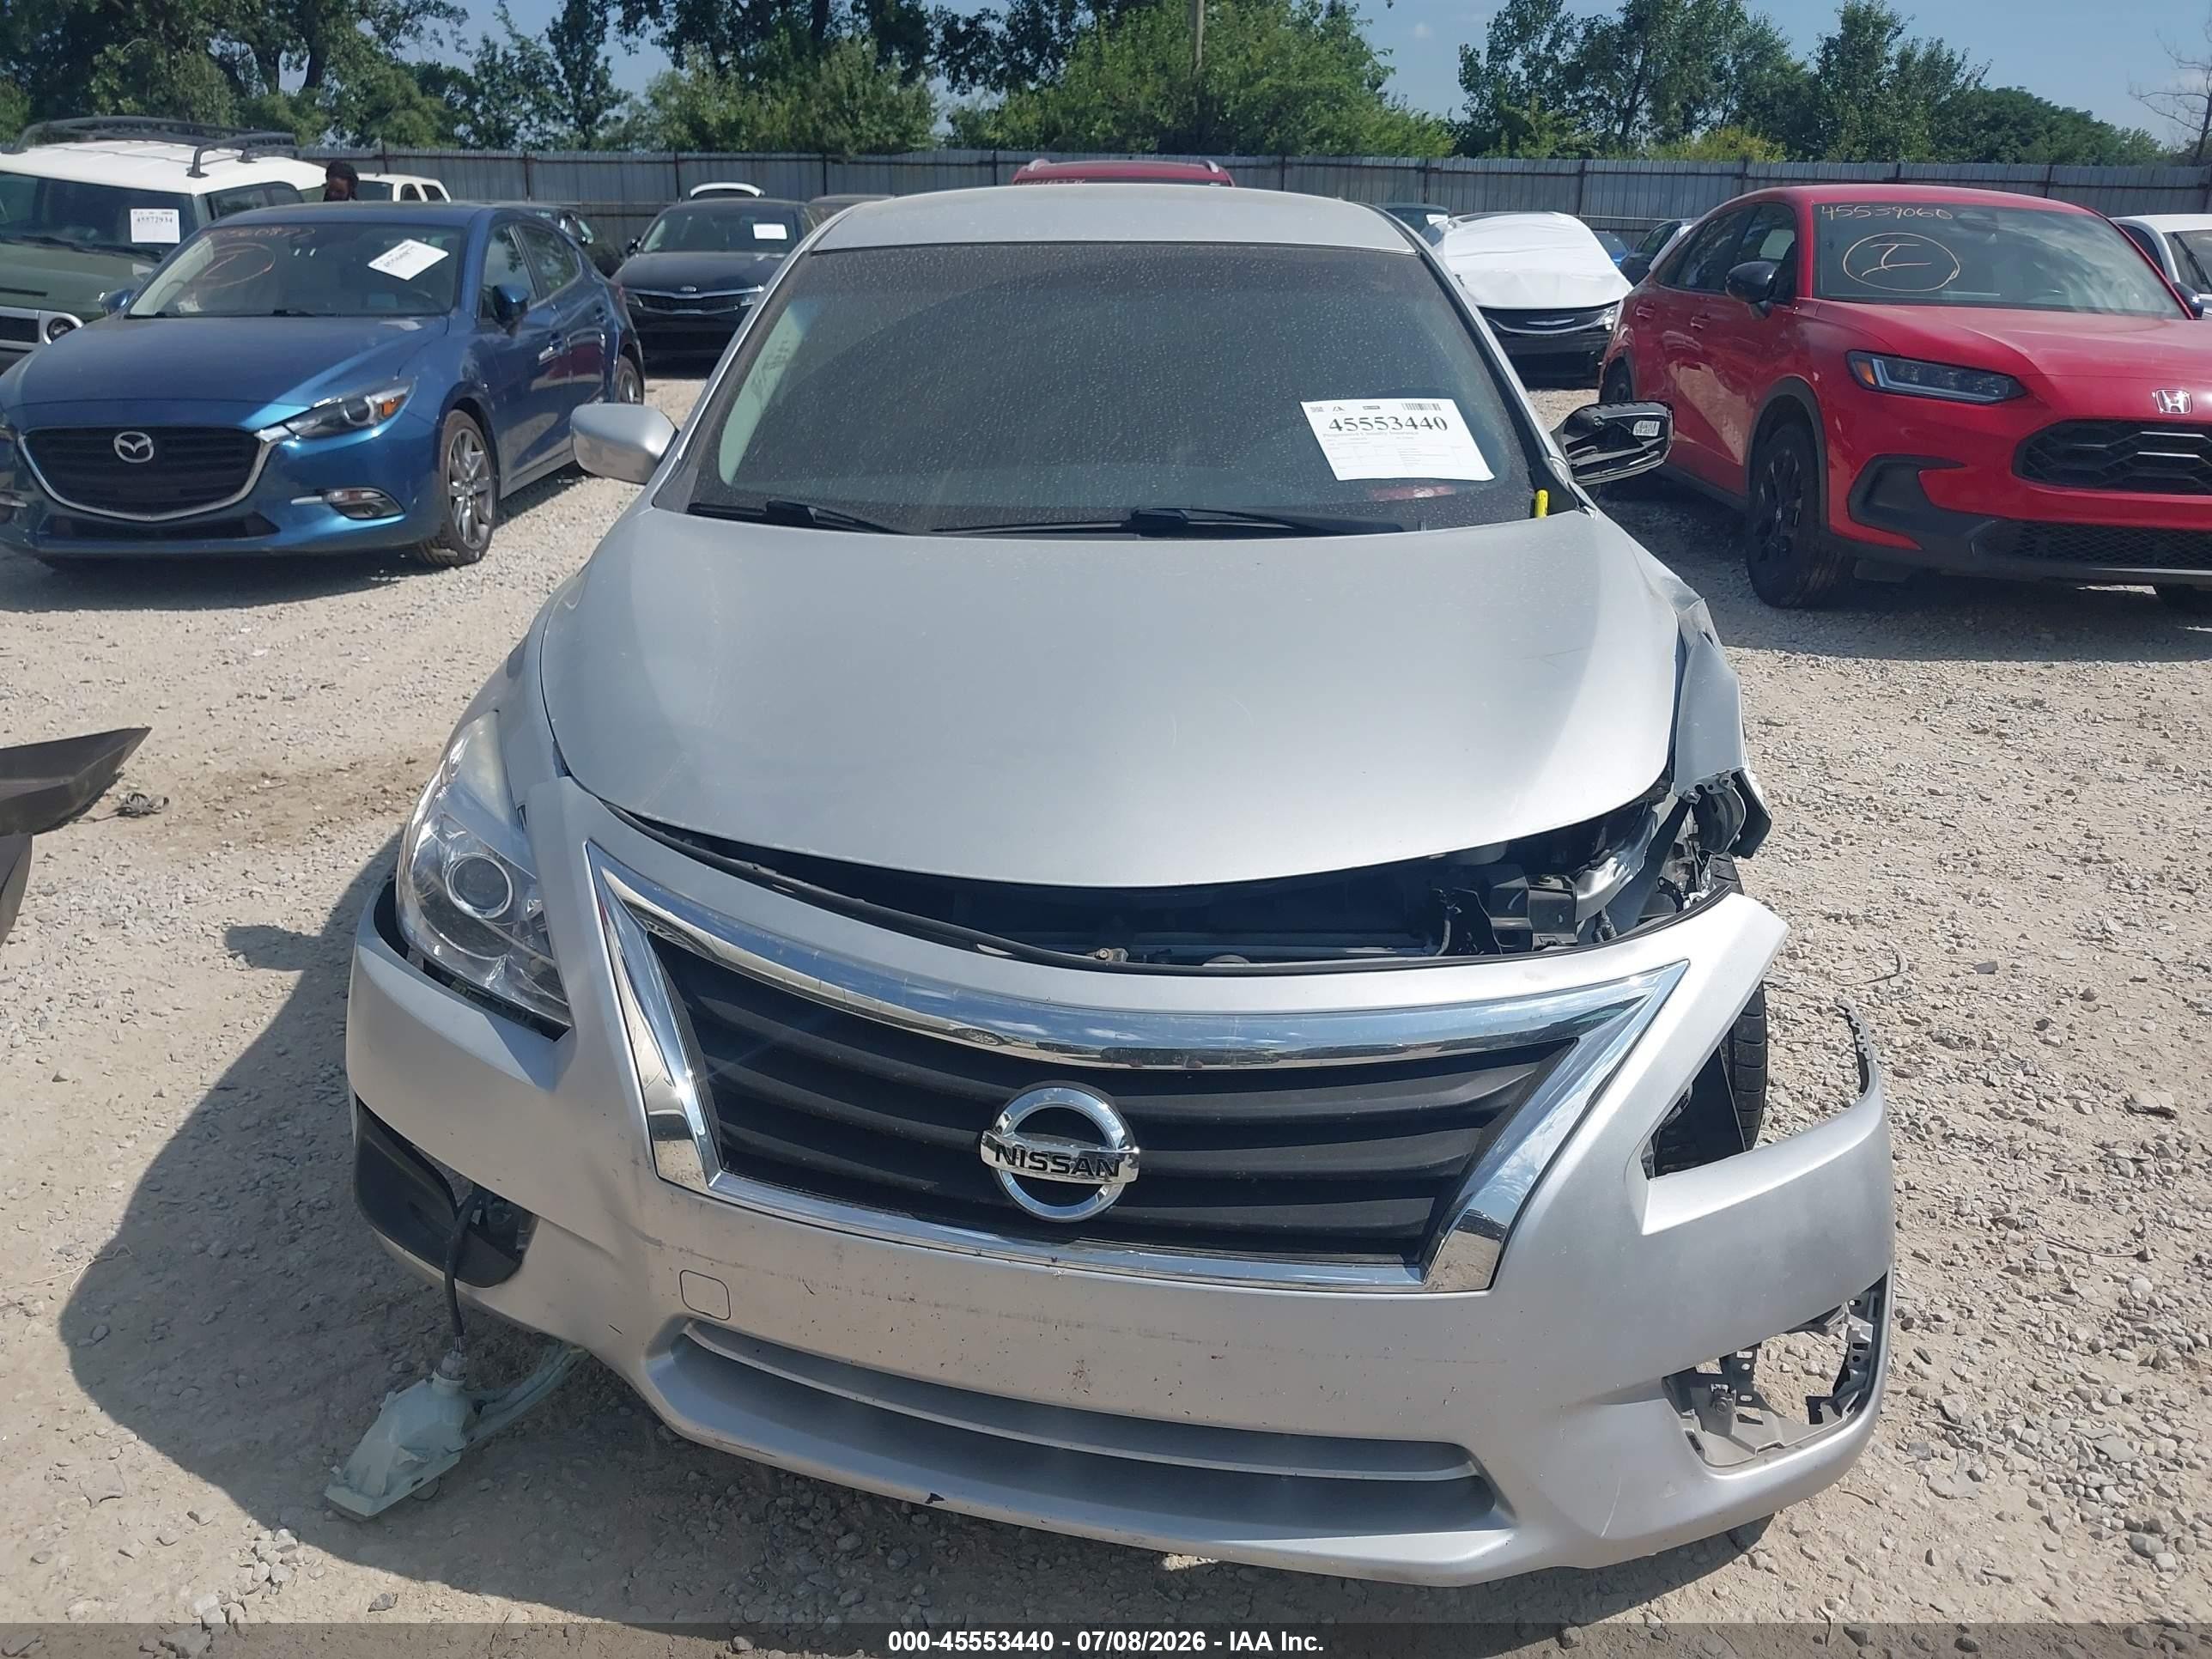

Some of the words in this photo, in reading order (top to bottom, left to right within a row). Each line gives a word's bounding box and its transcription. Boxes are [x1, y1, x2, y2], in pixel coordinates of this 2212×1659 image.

[1821, 204, 1954, 221] 45539060
[1328, 416, 1448, 432] 45553440
[995, 1144, 1121, 1177] NISSAN
